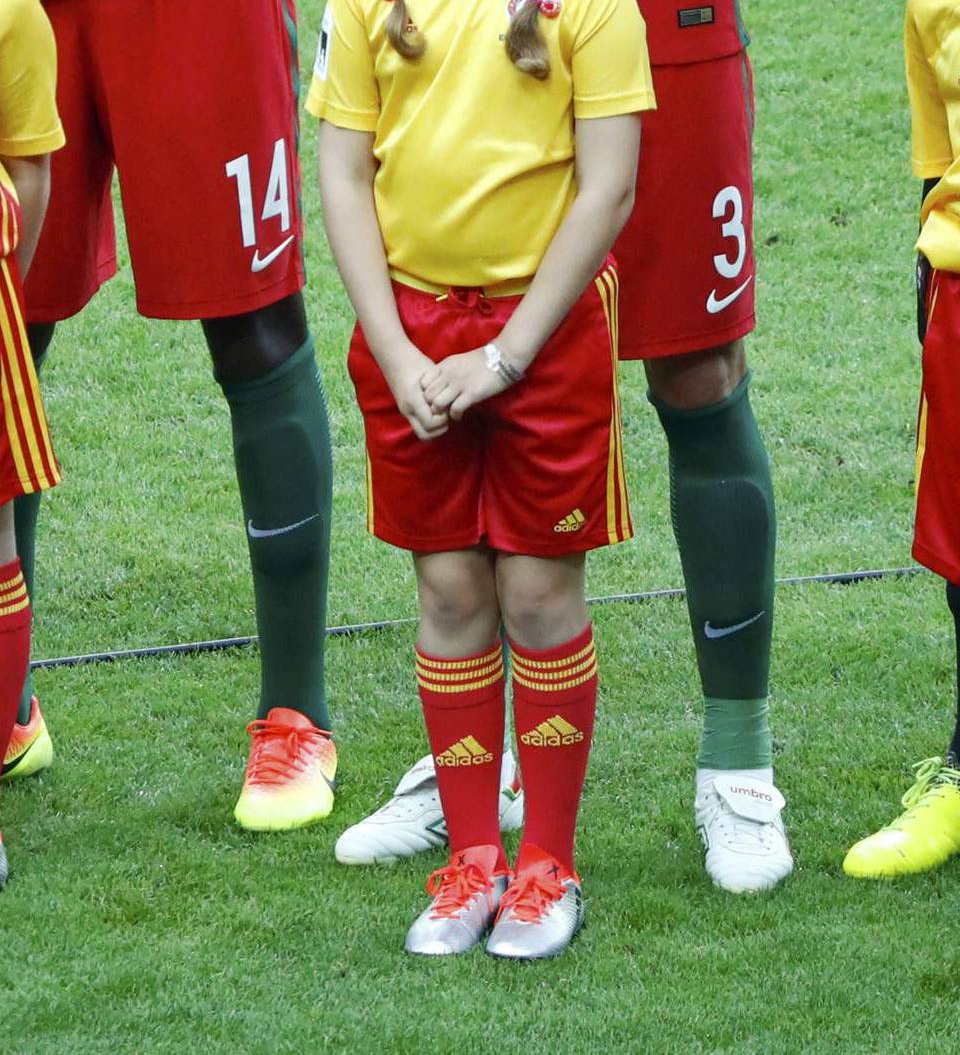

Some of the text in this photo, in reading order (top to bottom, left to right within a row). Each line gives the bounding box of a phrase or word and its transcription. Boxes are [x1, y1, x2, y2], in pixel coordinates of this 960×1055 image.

[225, 138, 291, 248] 14
[712, 186, 747, 279] 3
[520, 731, 584, 747] adidas
[435, 752, 494, 766] adidas
[730, 786, 773, 802] umbro
